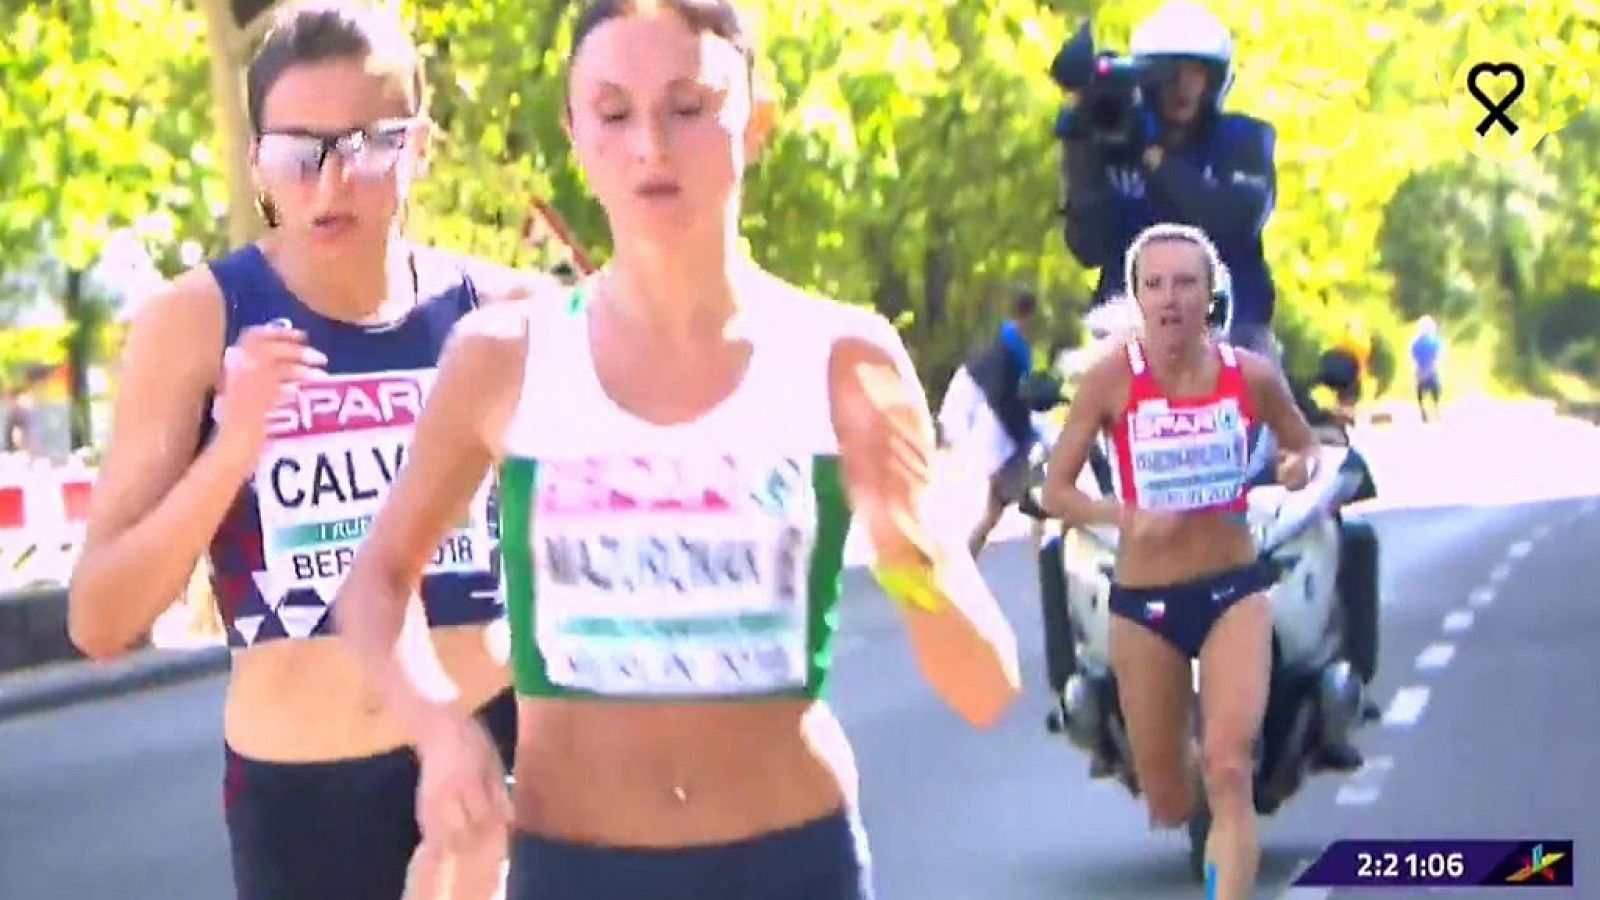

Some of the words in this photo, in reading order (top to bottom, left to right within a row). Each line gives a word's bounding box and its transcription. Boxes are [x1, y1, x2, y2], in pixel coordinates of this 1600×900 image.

[264, 380, 424, 434] SPAR
[270, 443, 404, 509] CALV
[292, 546, 354, 580] BER
